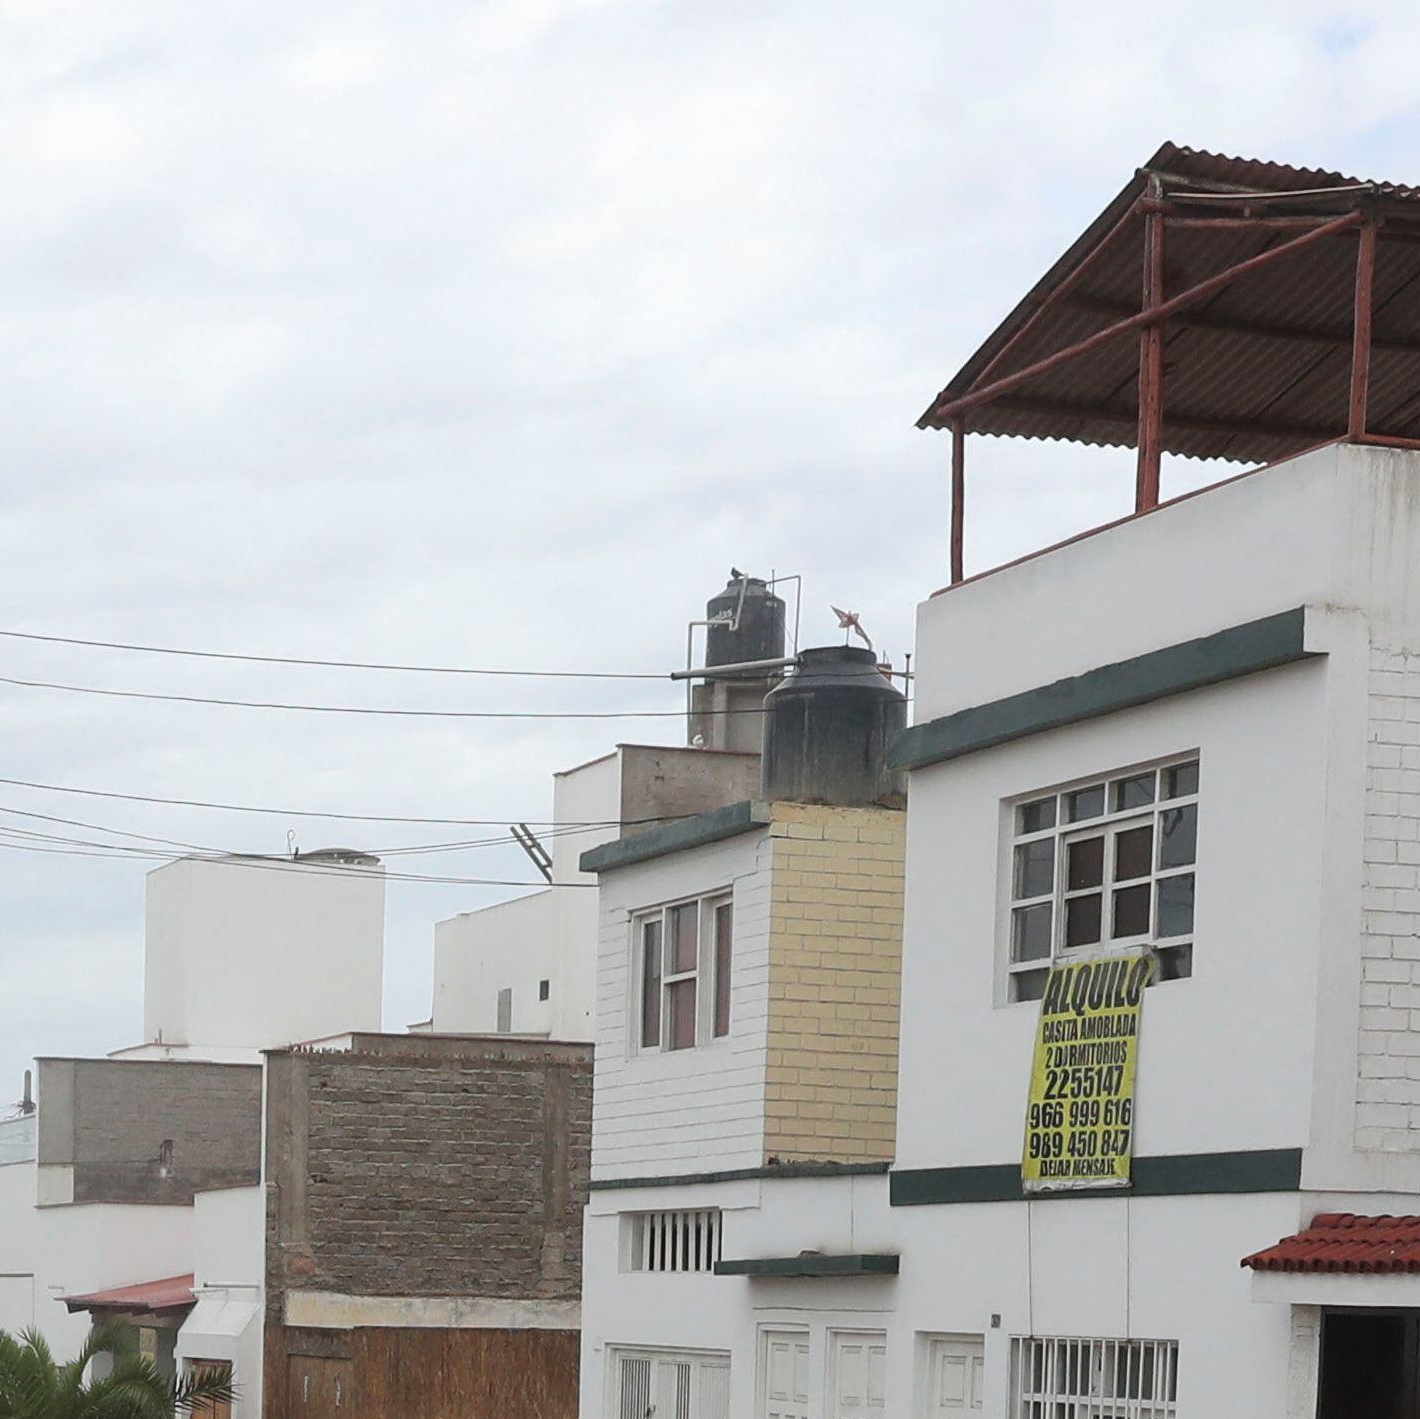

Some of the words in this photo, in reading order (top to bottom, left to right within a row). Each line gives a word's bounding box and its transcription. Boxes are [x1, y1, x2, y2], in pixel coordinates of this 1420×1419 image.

[1043, 959, 1149, 1016] ALQUILO
[1043, 1018, 1078, 1044] CASITA
[1080, 1013, 1136, 1040] AMOBLADA
[1045, 1047, 1054, 1069] 2
[1044, 1065, 1124, 1100] 2255147
[1030, 1101, 1063, 1129] 966
[1069, 1100, 1100, 1127] 999
[1103, 1098, 1132, 1126] 616
[1029, 1132, 1063, 1158] 989
[1067, 1130, 1097, 1157] 450
[1101, 1129, 1130, 1156] 847
[1040, 1159, 1071, 1177] DEJAR
[1072, 1158, 1116, 1176] MENSAJE
